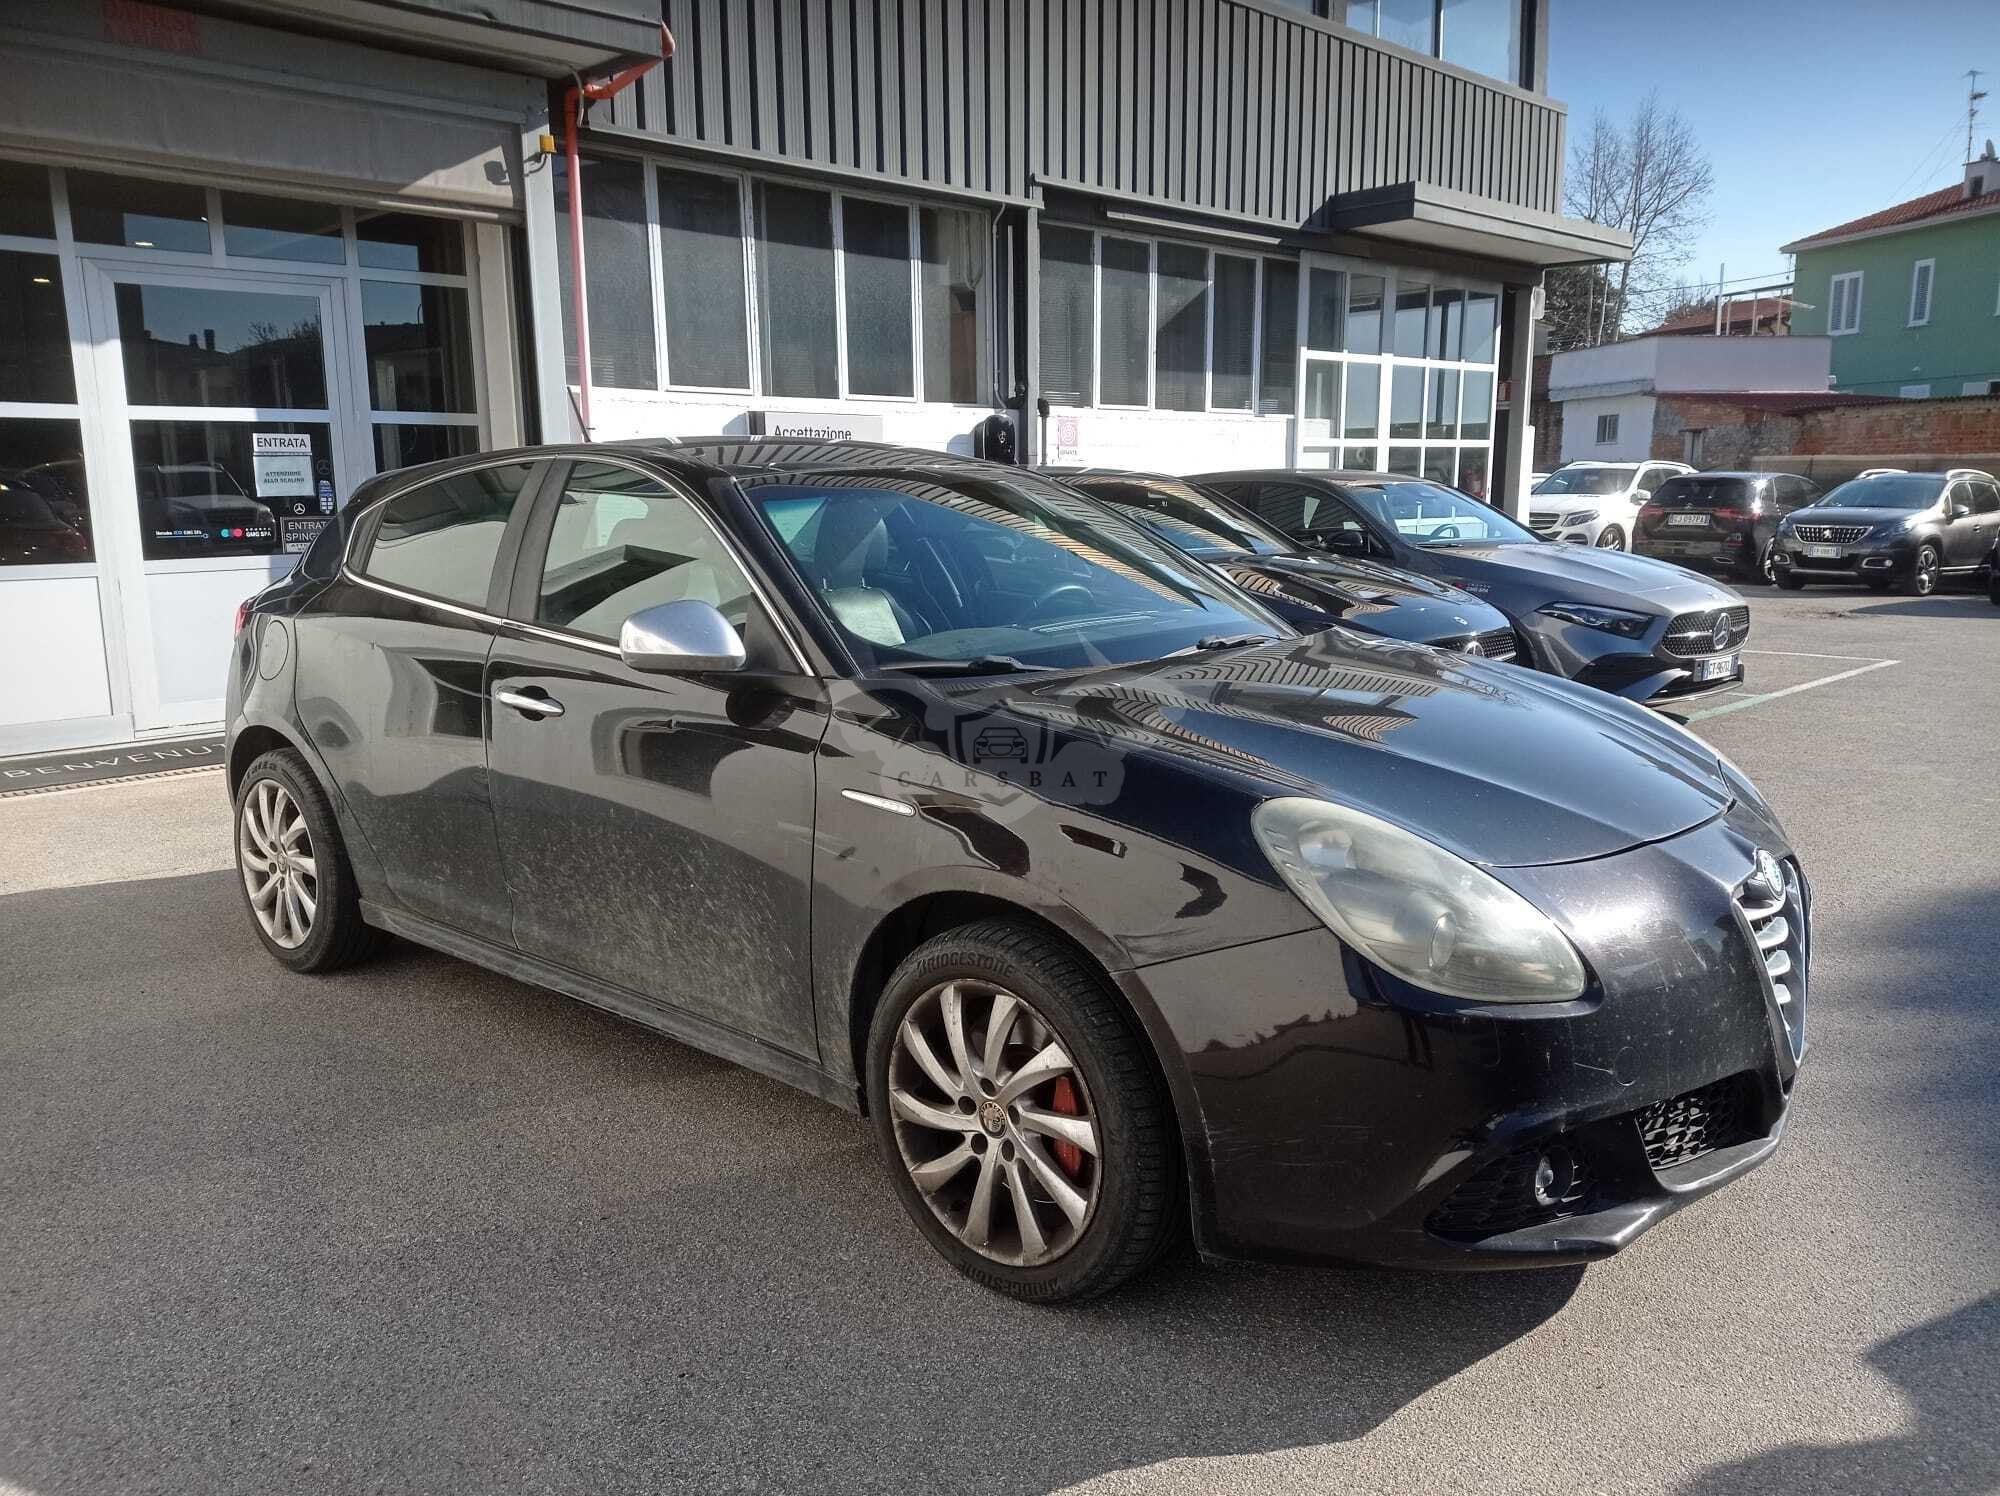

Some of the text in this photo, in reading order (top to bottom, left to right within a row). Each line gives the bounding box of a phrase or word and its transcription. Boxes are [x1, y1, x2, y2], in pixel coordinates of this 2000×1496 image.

[774, 424, 852, 440] Accettazione
[256, 437, 308, 449] ENTRATA
[288, 521, 327, 531] ENTRAT
[285, 532, 320, 542] SPING
[915, 950, 1017, 978] BRIDGESTONE
